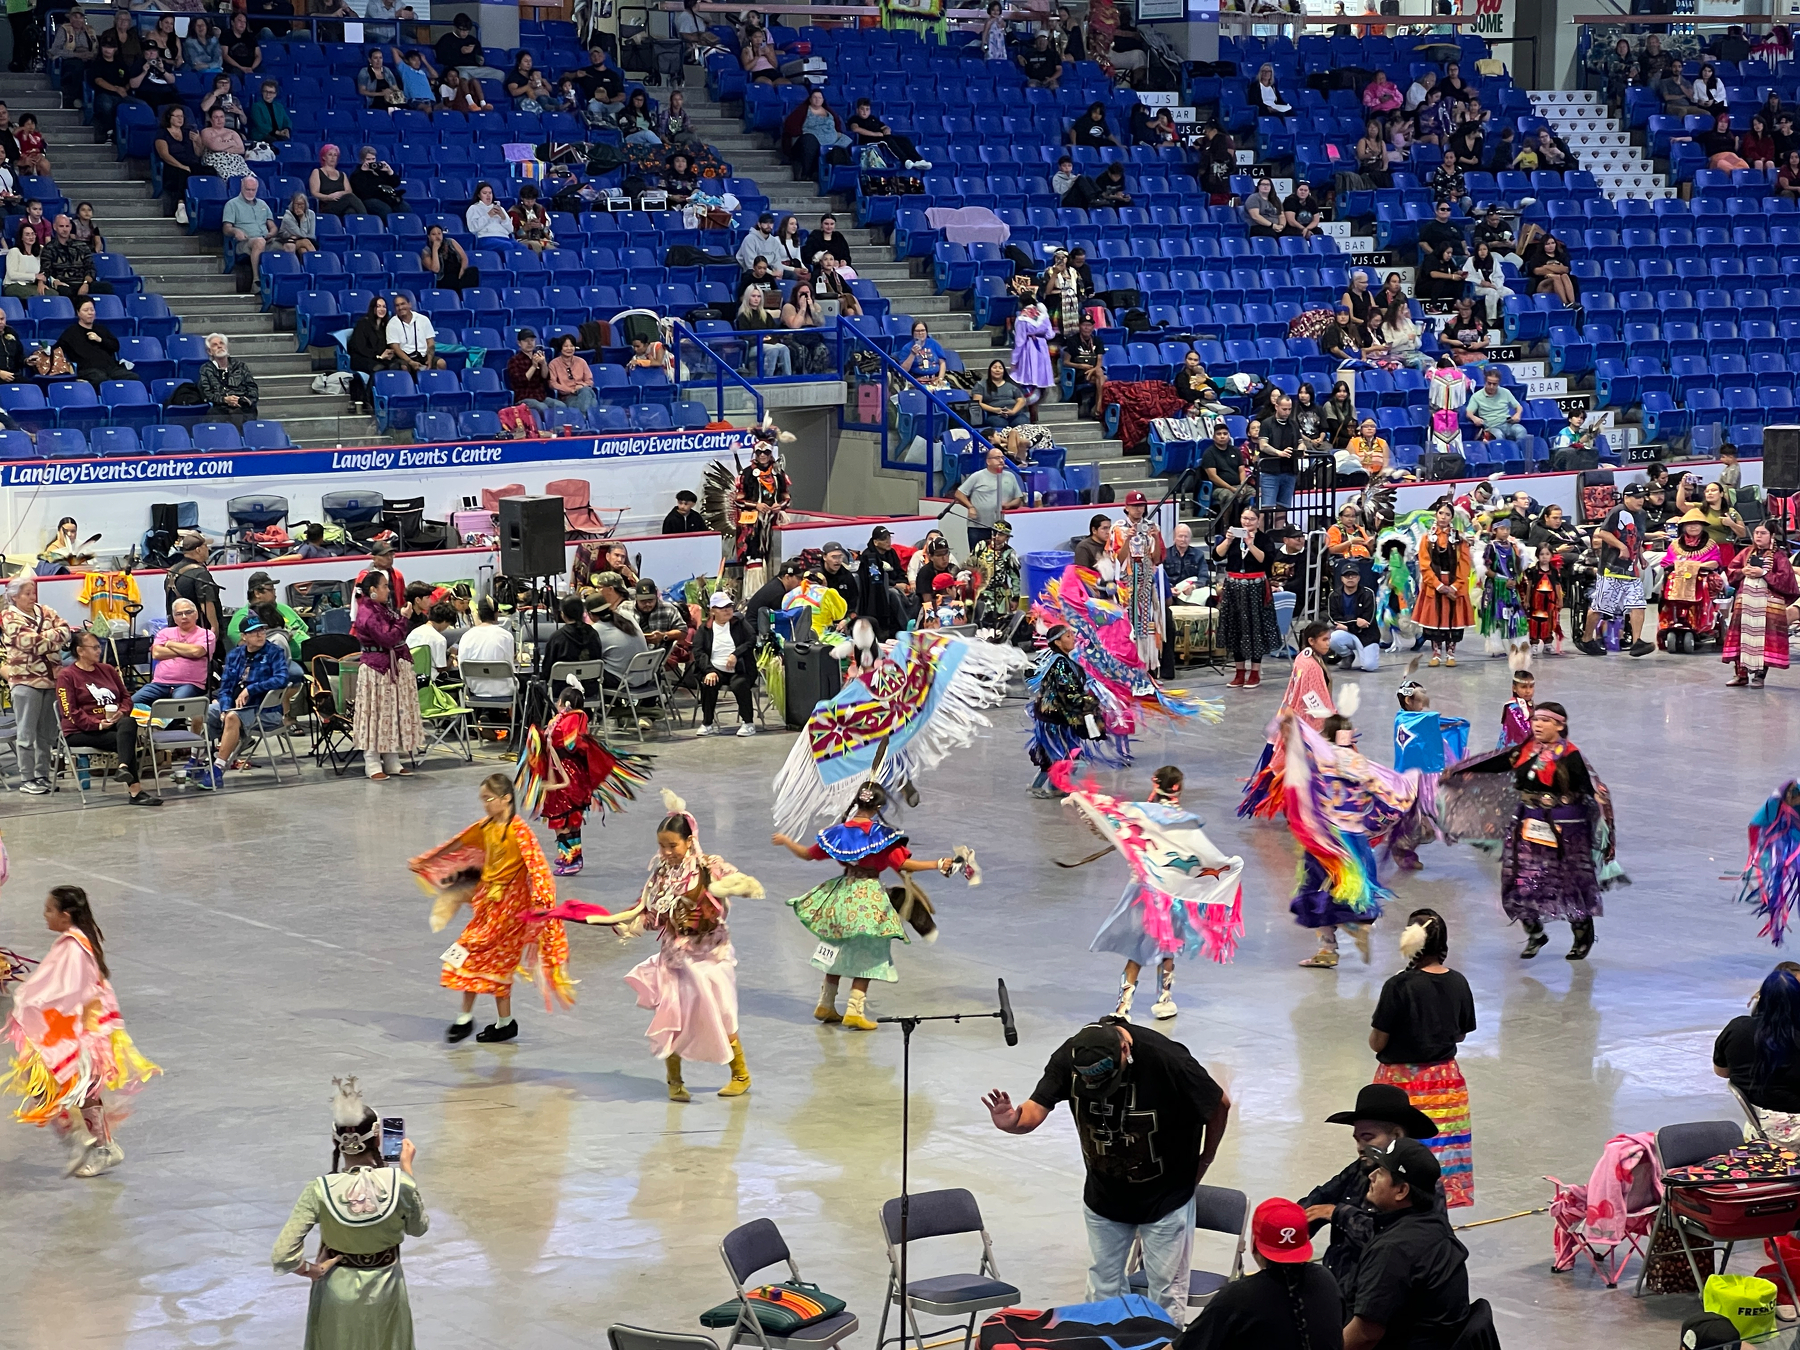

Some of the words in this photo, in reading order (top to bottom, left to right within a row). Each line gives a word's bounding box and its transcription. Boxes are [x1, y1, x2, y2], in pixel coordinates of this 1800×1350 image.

[1328, 224, 1345, 235] J'S
[1345, 241, 1365, 250] BAR
[1520, 366, 1538, 377] J'S
[1529, 383, 1536, 393] &
[1539, 381, 1560, 392] BAR
[332, 450, 395, 471] Langley
[398, 448, 449, 467] Events
[451, 445, 502, 464] Centre
[9, 459, 233, 485] LangleyEventsCentre.com
[1278, 1227, 1297, 1244] R
